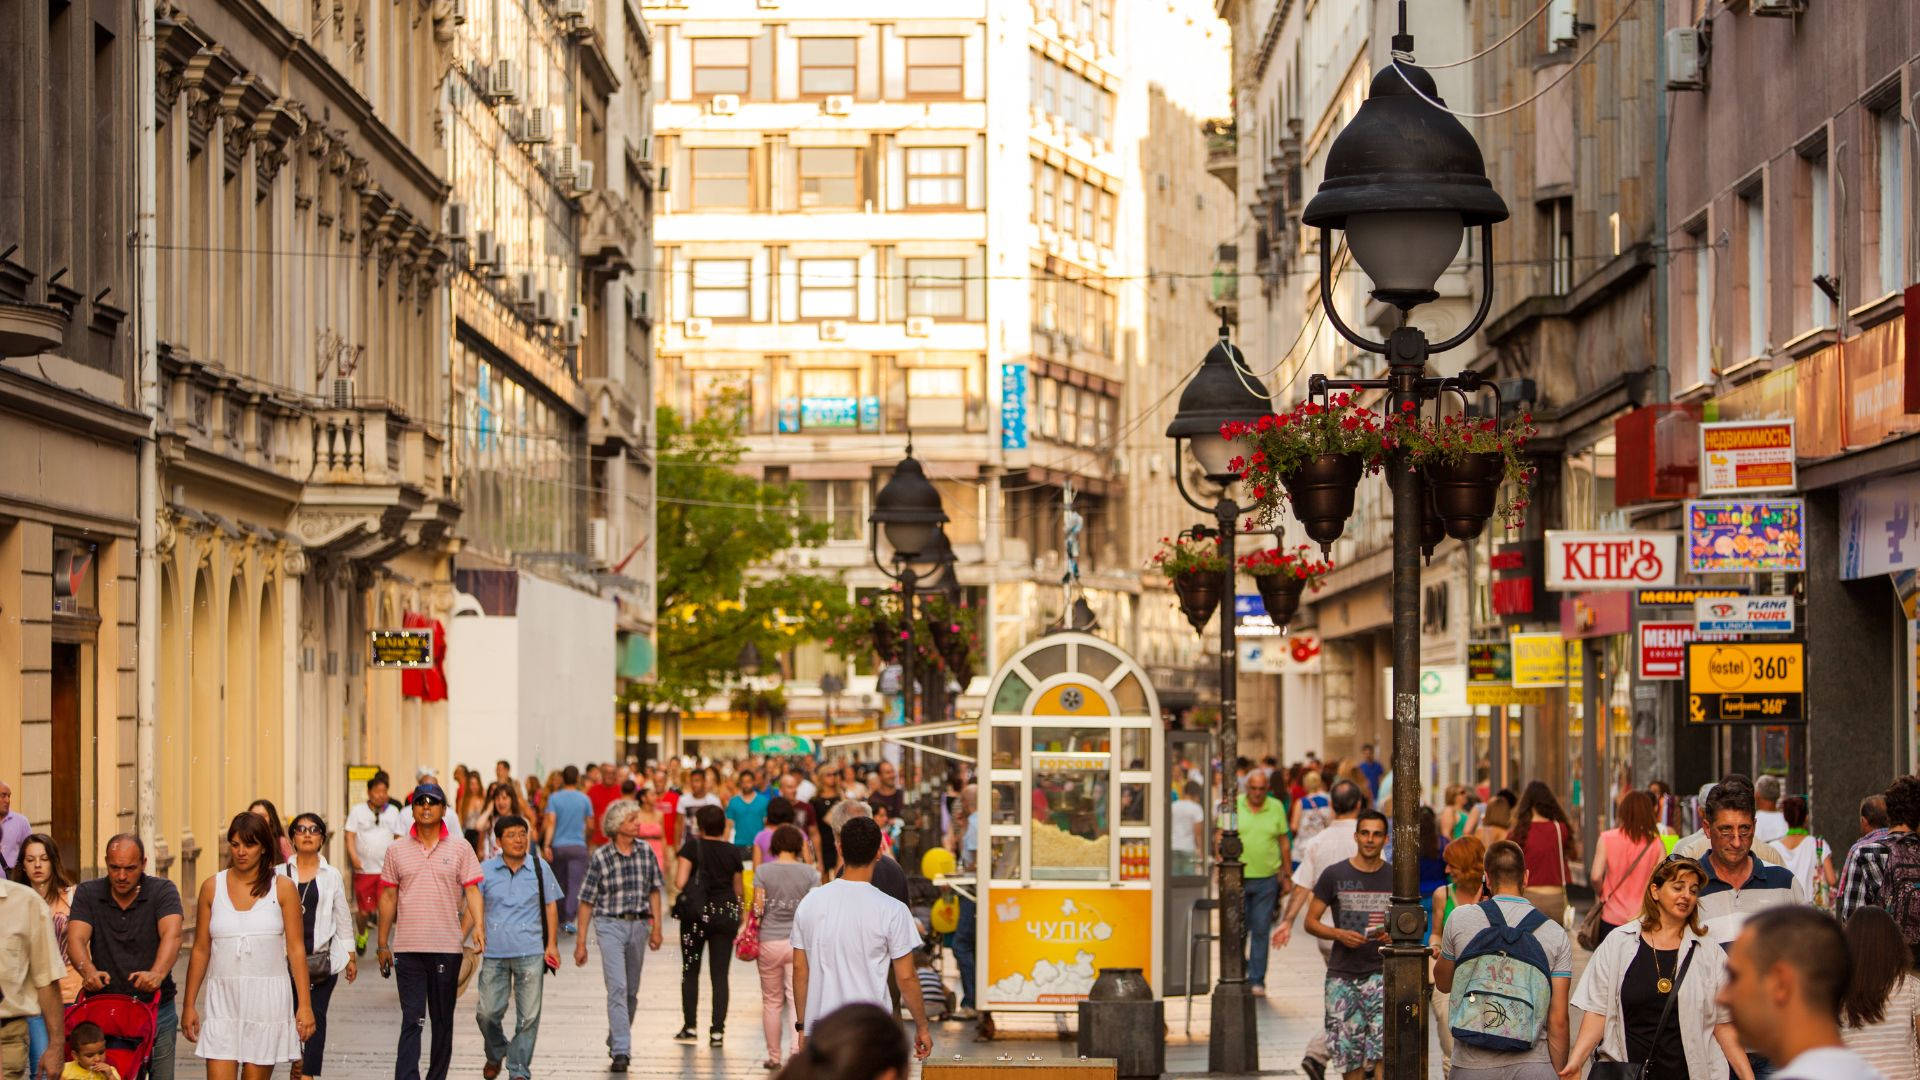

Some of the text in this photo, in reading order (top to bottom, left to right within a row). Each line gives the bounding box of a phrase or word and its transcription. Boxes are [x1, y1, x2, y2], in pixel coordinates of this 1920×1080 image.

[1748, 601, 1787, 609] PLANA
[1748, 611, 1787, 620] TOURS
[1753, 656, 1796, 679] 360°
[1039, 759, 1104, 769] POPCORN
[1337, 880, 1364, 890] USA
